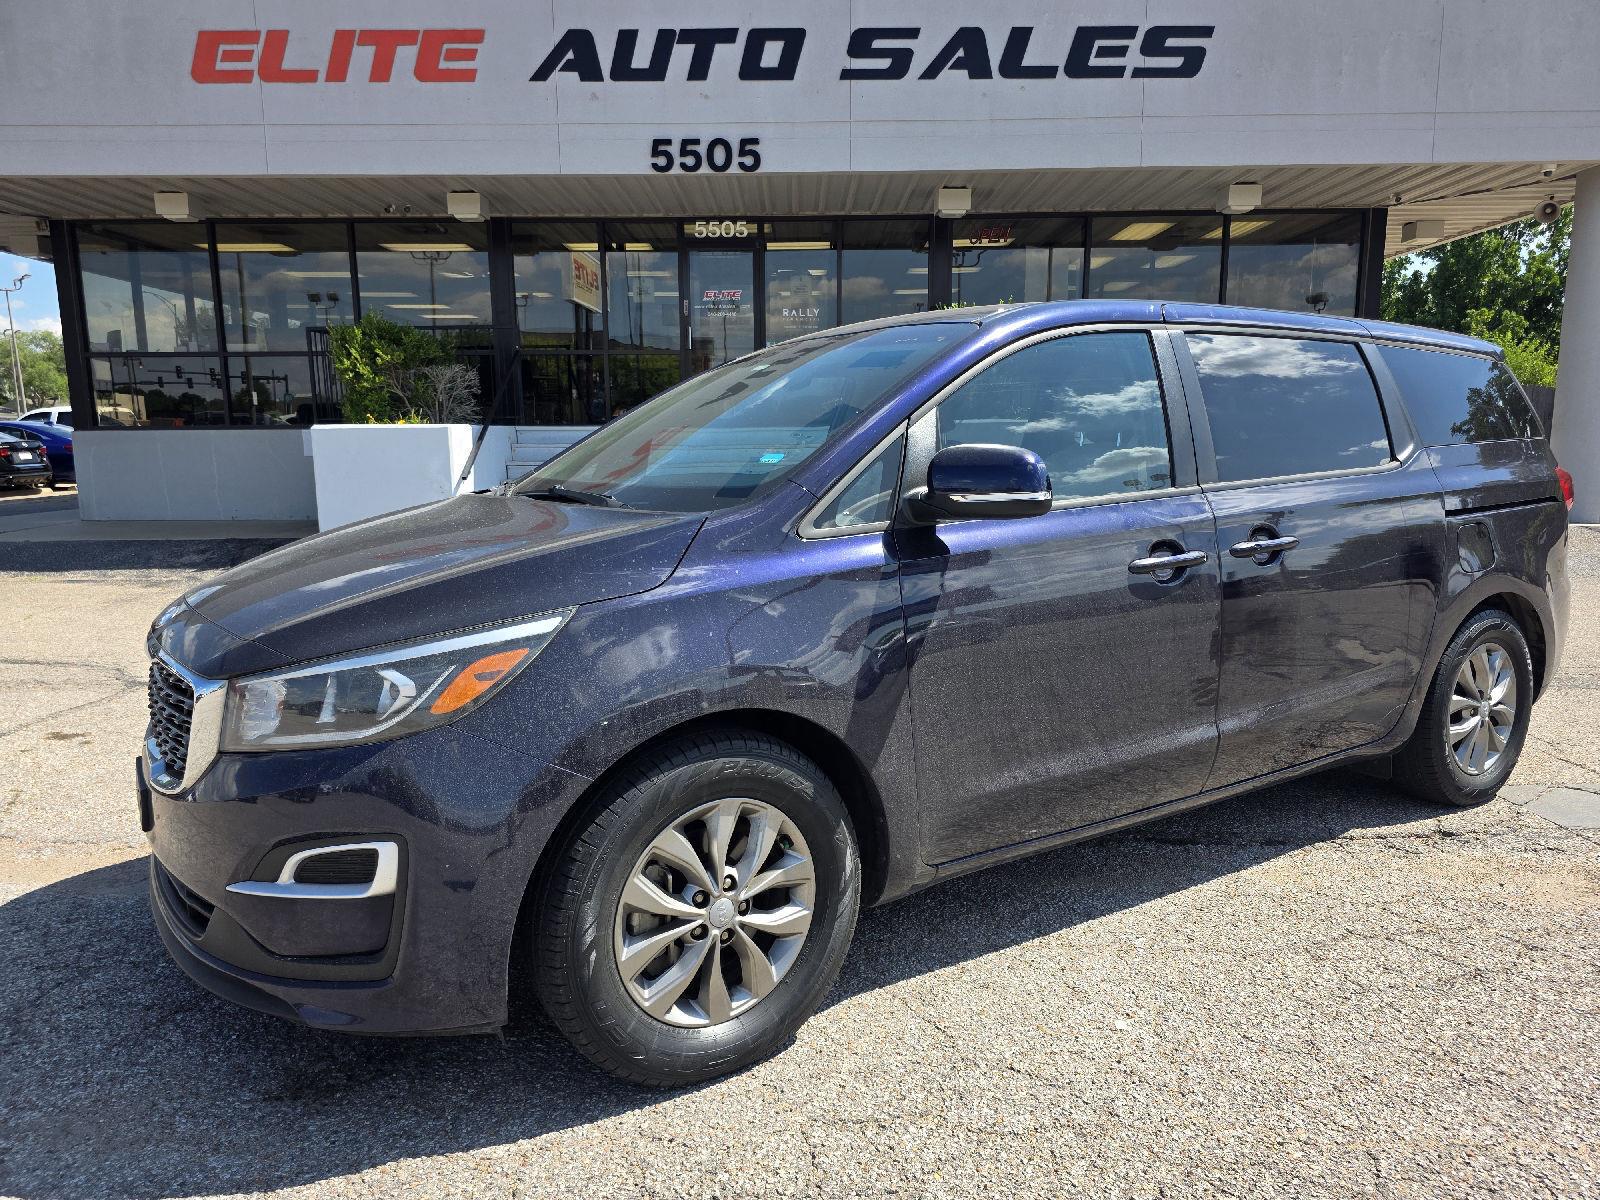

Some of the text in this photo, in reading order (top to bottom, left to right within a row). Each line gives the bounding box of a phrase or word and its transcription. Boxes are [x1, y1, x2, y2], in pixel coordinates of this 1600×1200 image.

[191, 26, 1215, 84] ELITE AUTO SALES
[650, 138, 762, 172] 5505
[695, 221, 748, 238] 5505
[969, 225, 1010, 245] OPEN
[704, 290, 742, 298] ELITE
[783, 308, 820, 317] RALLY
